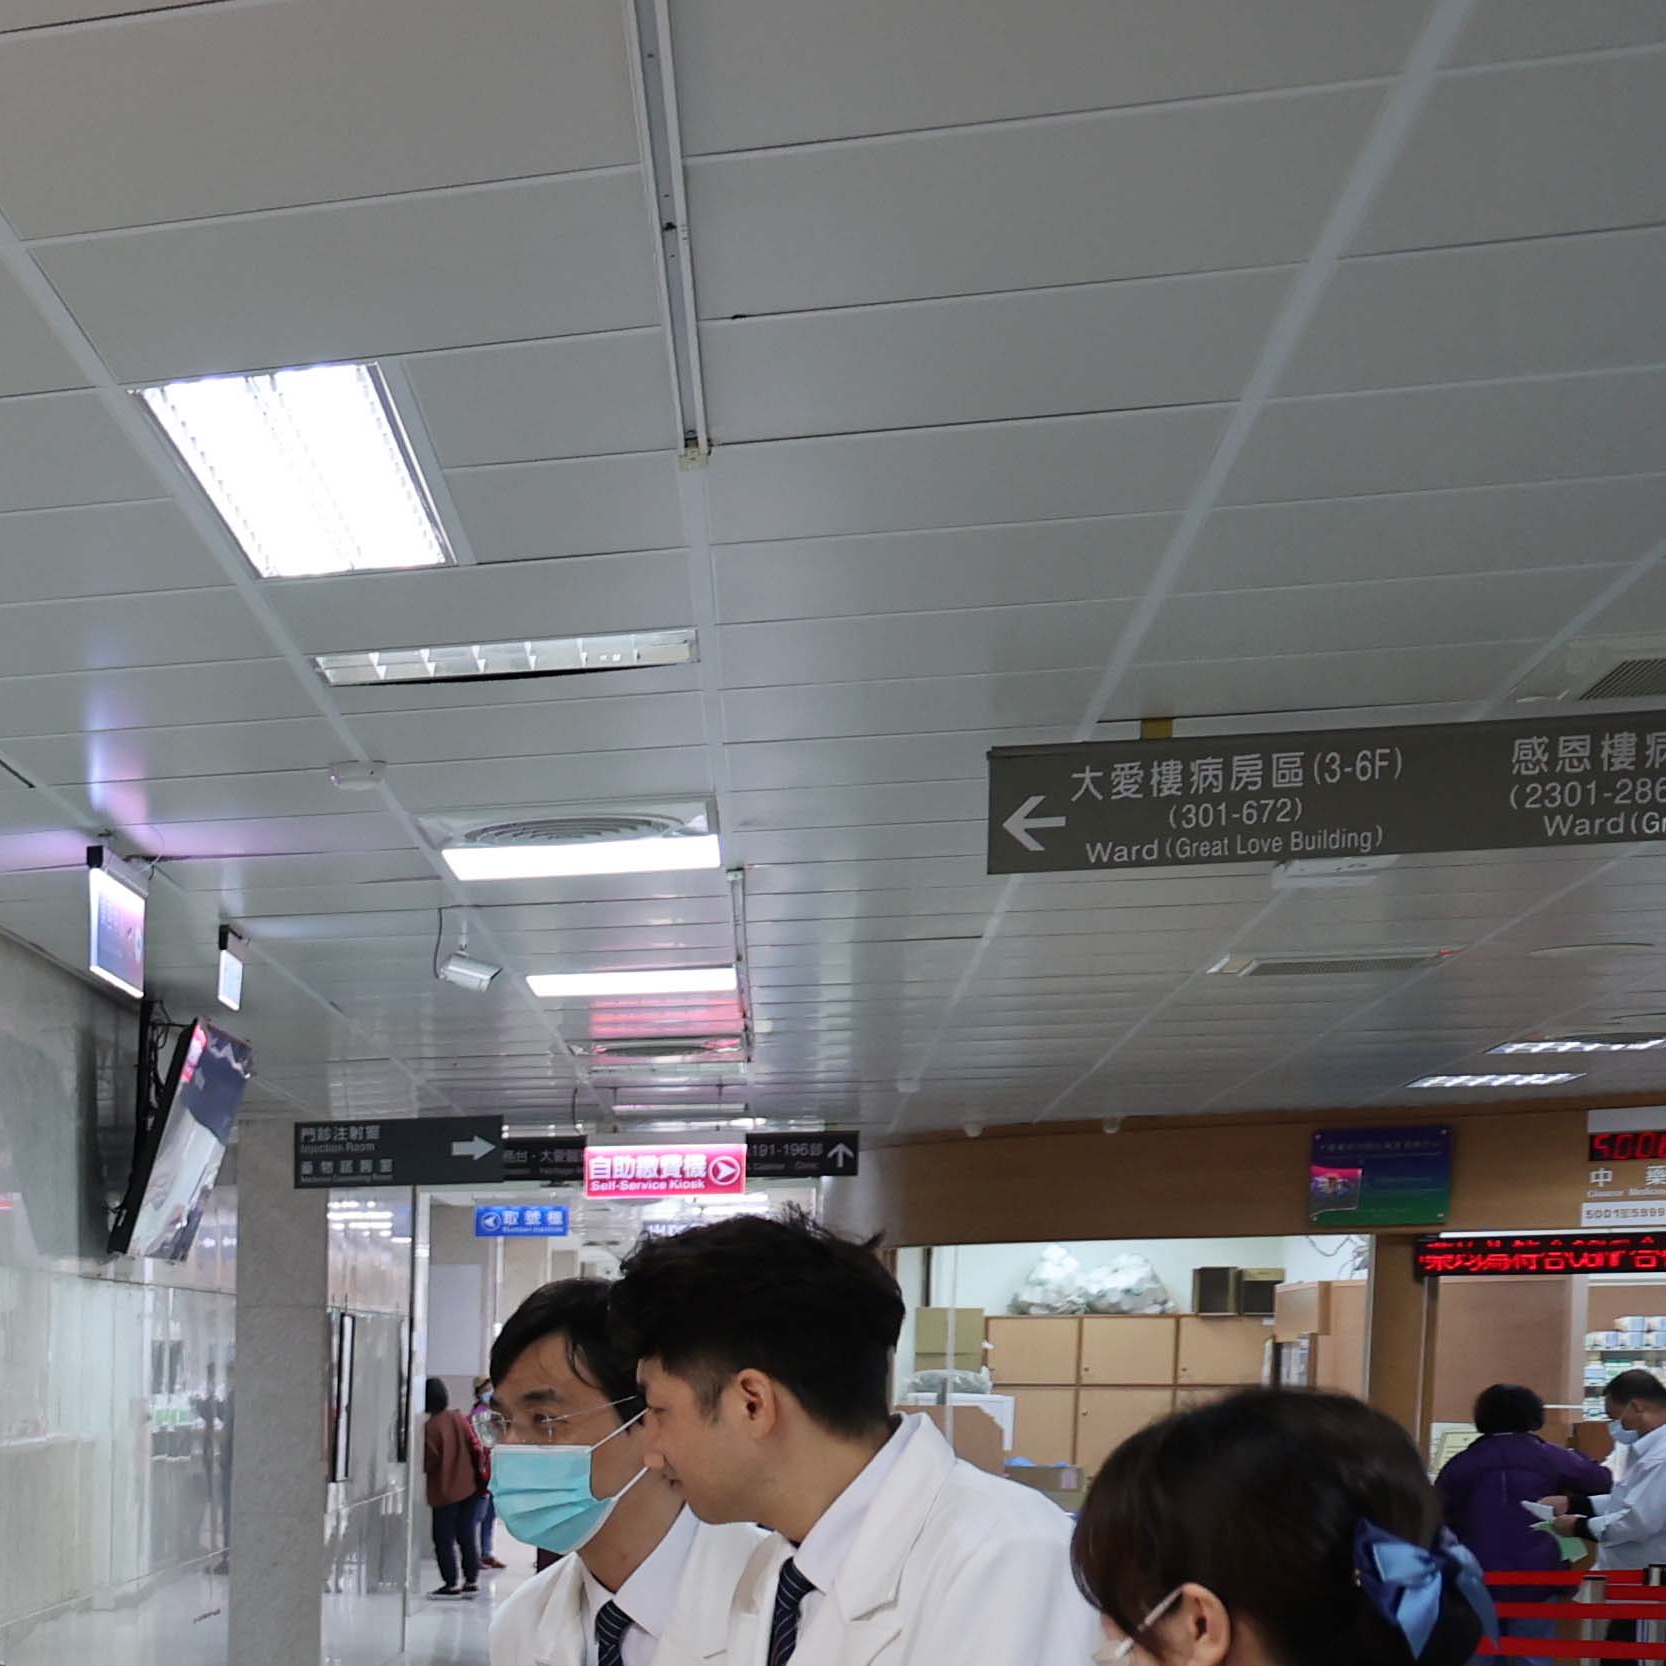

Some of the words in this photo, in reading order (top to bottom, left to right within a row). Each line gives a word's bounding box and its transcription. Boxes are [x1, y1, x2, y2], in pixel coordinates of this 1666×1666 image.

[1071, 746, 1404, 803] 大愛樓病房區(3-6F)
[1169, 798, 1303, 829] (301-672)
[1544, 811, 1625, 838] Ward
[1085, 840, 1160, 864] Ward
[1165, 837, 1231, 859] (Great
[1236, 834, 1284, 856] Love
[1290, 825, 1385, 854] Building)
[345, 1142, 376, 1152] Room
[590, 1179, 667, 1192] Self-Service
[669, 1178, 706, 1191] Kiosk
